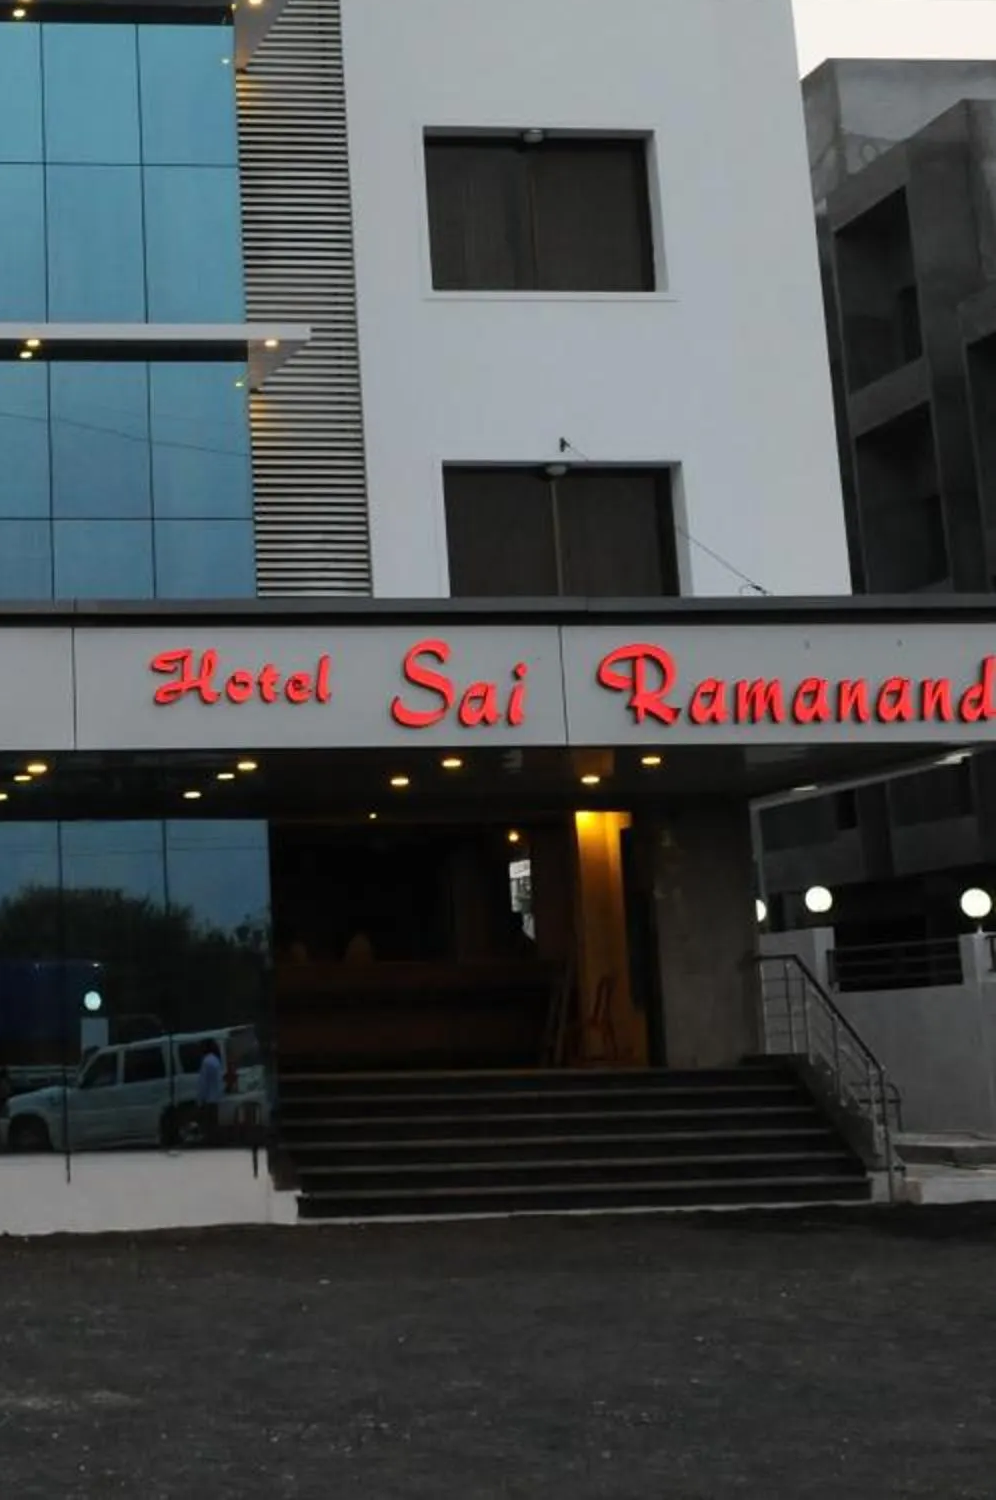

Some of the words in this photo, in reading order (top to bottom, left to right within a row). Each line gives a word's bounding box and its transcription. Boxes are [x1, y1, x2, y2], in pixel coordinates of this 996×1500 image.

[150, 648, 332, 705] Hotel
[390, 638, 528, 728] Sai
[597, 642, 996, 726] Ramanand
